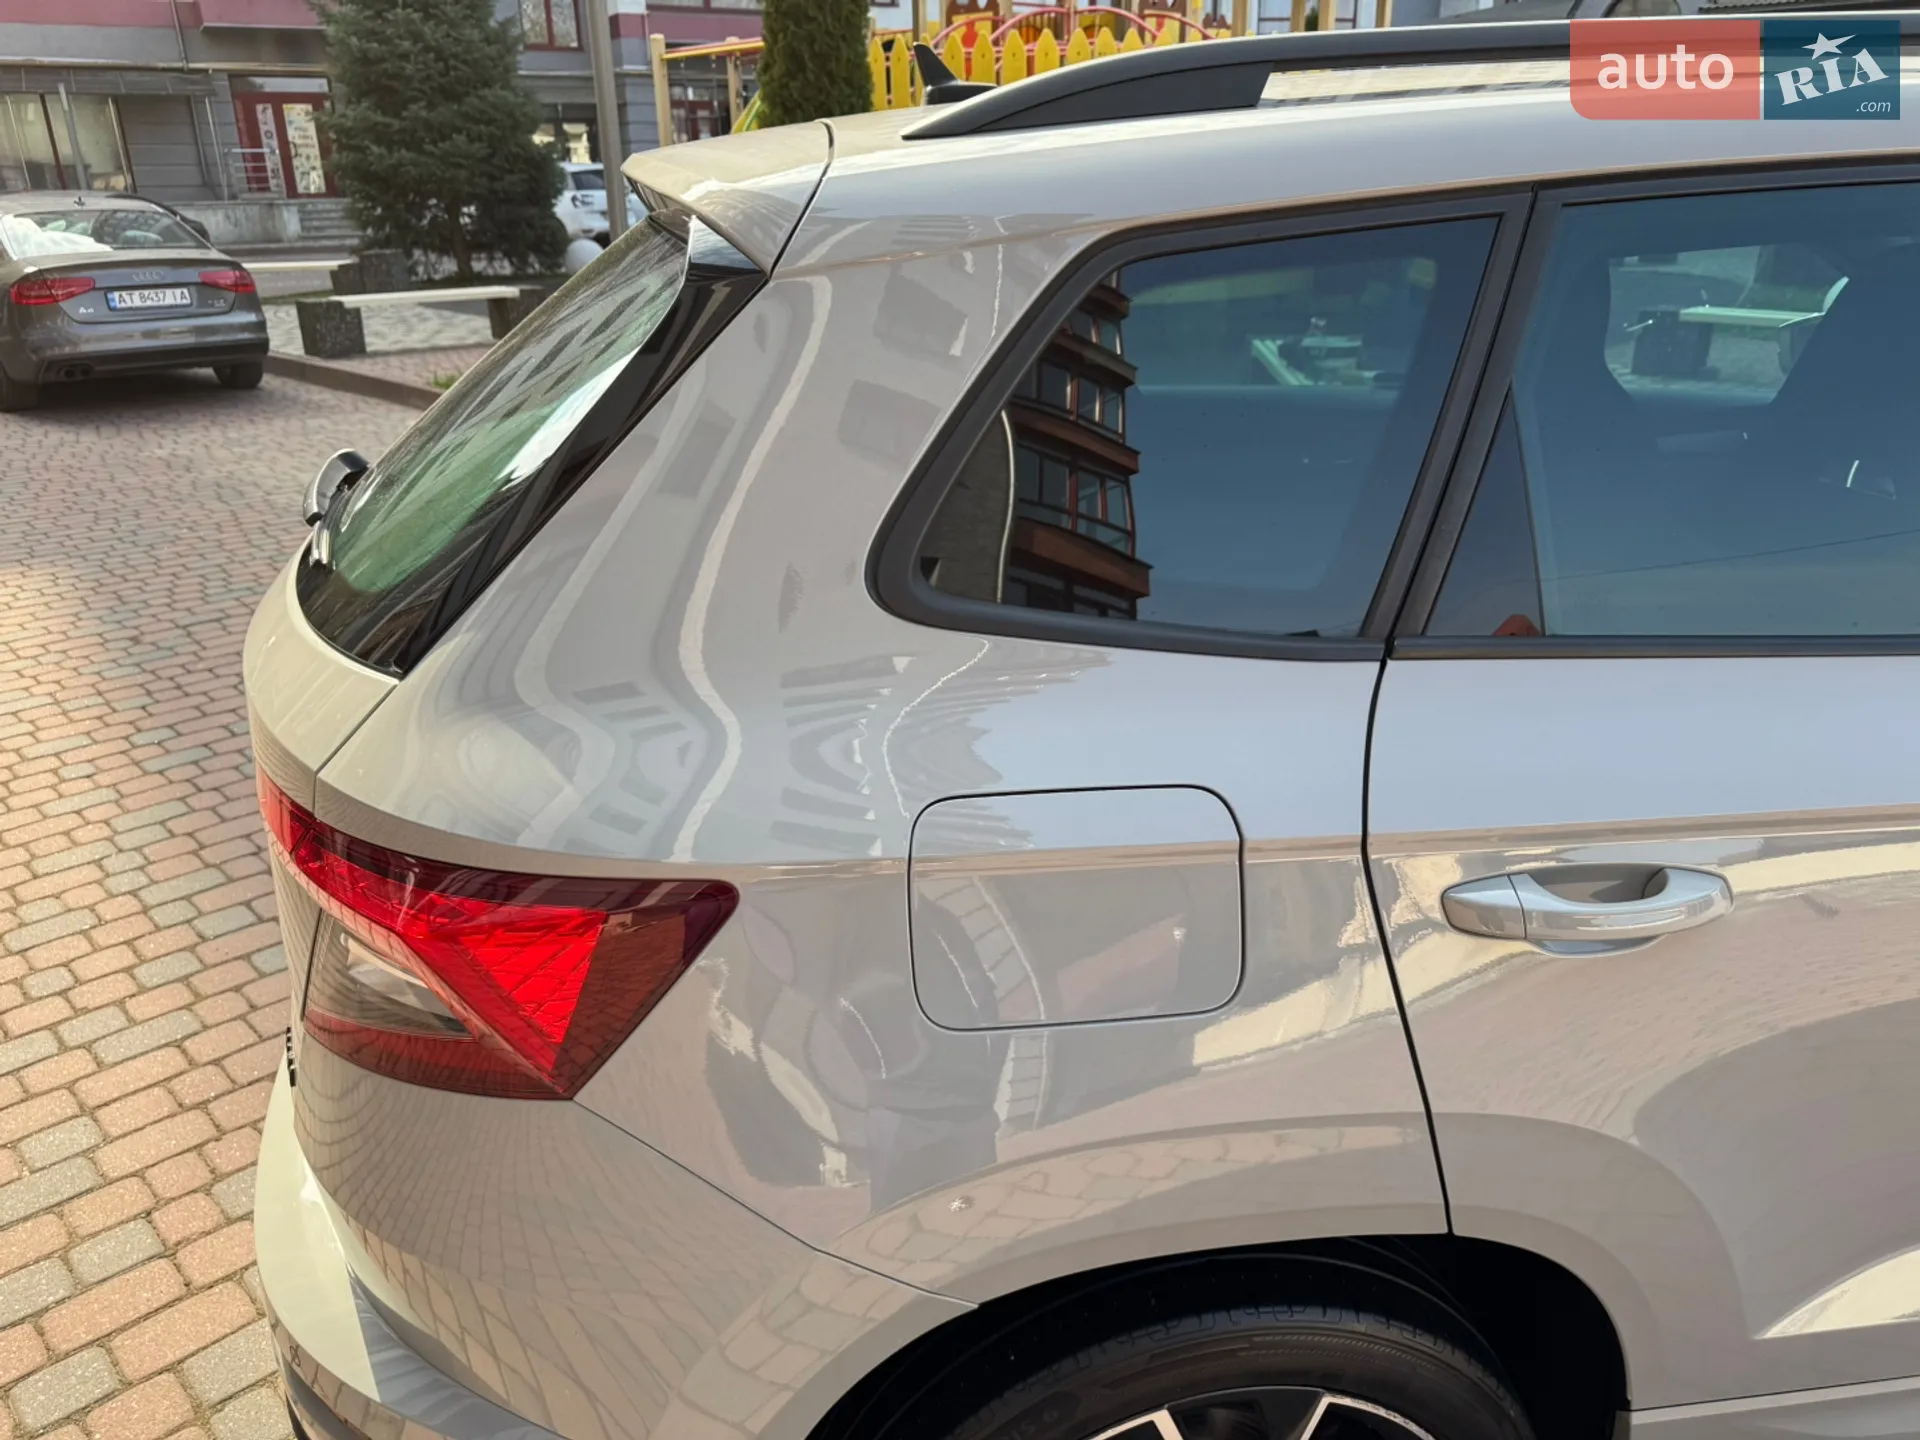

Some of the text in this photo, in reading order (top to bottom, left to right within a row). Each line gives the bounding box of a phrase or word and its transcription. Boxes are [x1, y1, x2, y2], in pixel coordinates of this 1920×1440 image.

[118, 289, 189, 305] AT 8437 IA
